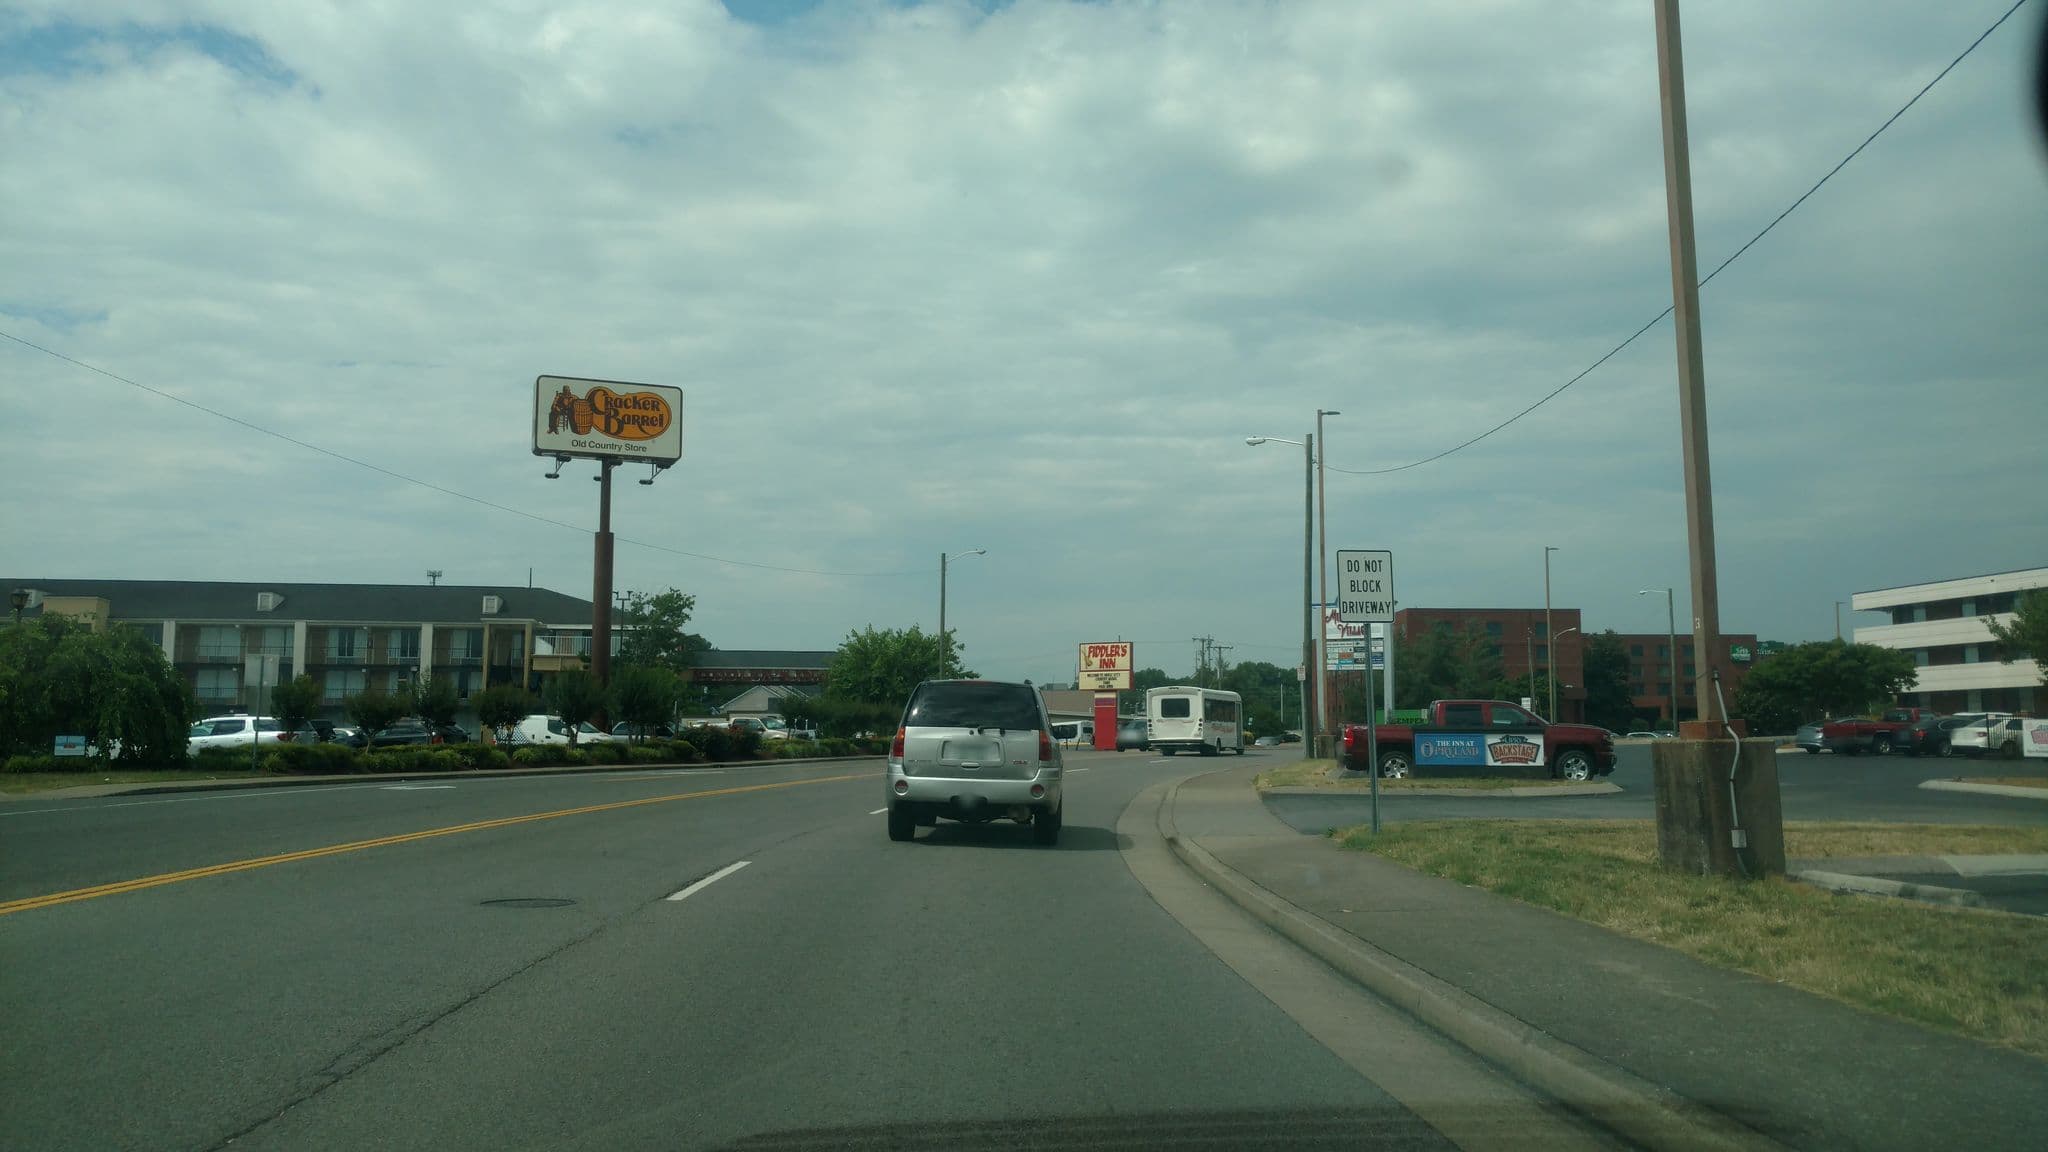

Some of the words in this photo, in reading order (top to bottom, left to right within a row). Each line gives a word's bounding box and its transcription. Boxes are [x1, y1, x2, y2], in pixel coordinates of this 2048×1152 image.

[571, 439, 587, 448] Old
[588, 441, 623, 452] Country
[625, 443, 647, 452] Store
[1347, 559, 1360, 573] DO
[1364, 559, 1383, 573] NOT
[1350, 580, 1382, 593] BLOCK
[1342, 601, 1391, 614] DRIVEWAY
[1088, 645, 1127, 658] FIDDLER'S
[1099, 658, 1116, 668] INN
[1494, 744, 1536, 758] BACKSTAGE
